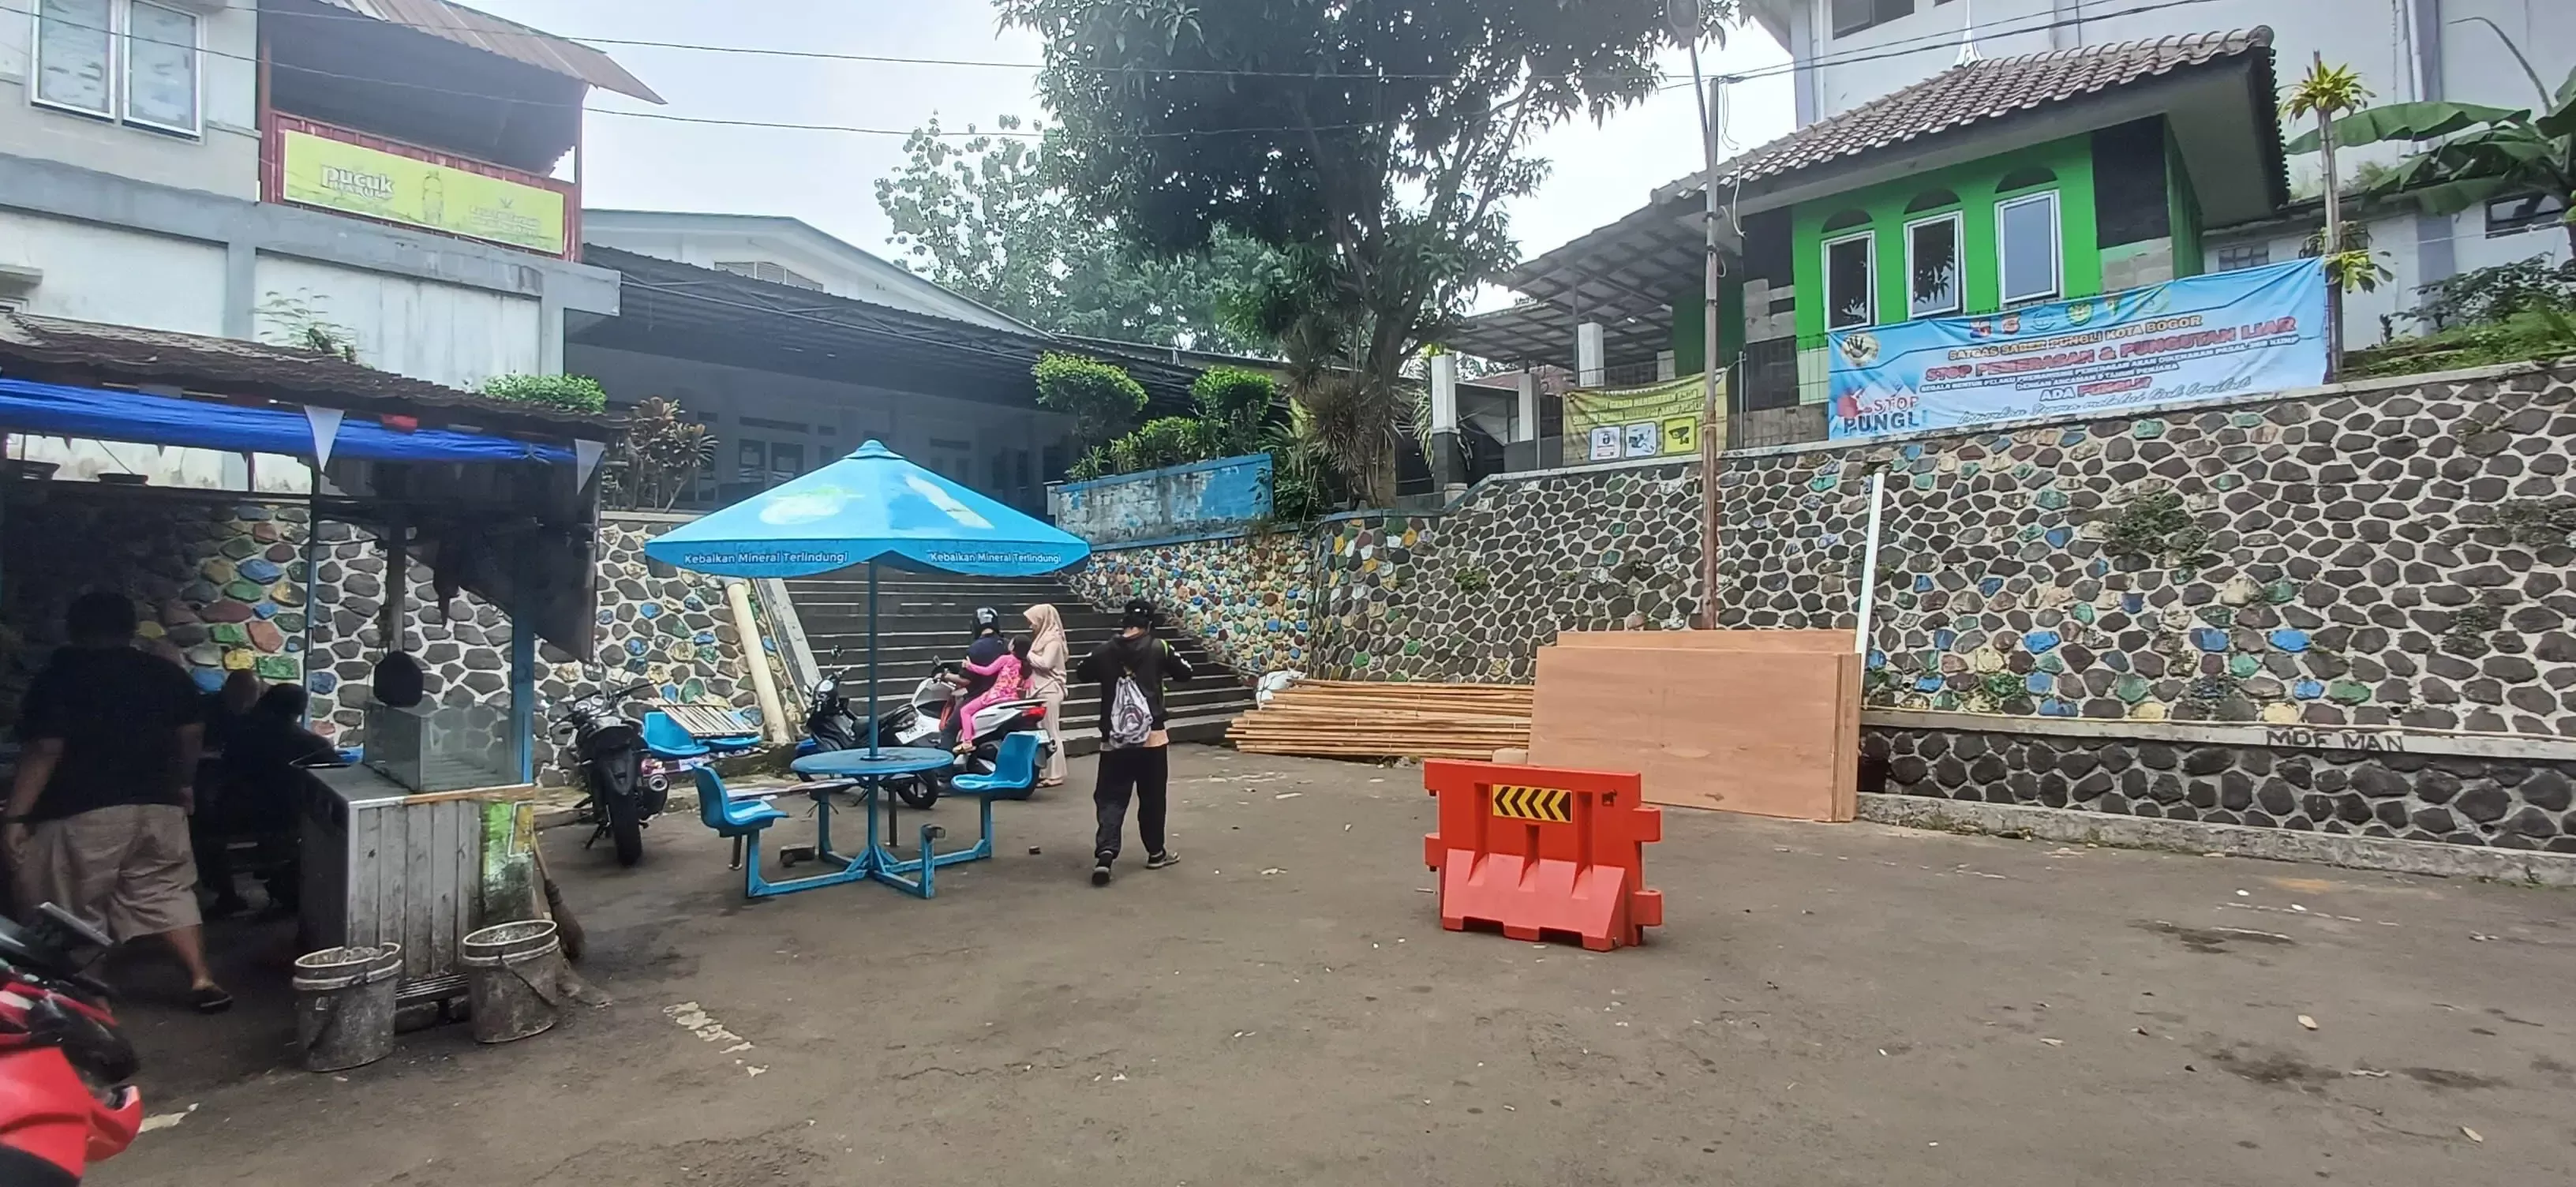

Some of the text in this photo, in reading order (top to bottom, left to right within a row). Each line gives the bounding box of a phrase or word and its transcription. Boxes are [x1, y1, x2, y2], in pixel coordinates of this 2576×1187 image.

[320, 164, 395, 193] pucuk
[1948, 315, 2203, 361] SATGAS SABER PUNGLI KOTA BOGOR
[1926, 364, 1972, 381] STOP
[2099, 346, 2116, 361] &
[2119, 328, 2236, 358] PUNGUTAN
[2241, 316, 2297, 339] LIAR
[2039, 387, 2076, 402] ADA
[1874, 396, 1919, 413] STOP
[684, 551, 848, 565] Kebaikan Mineral Terlindungi
[930, 552, 1062, 565] Kebaikan Mineral Terlindungi
[2342, 732, 2406, 751] MAN
